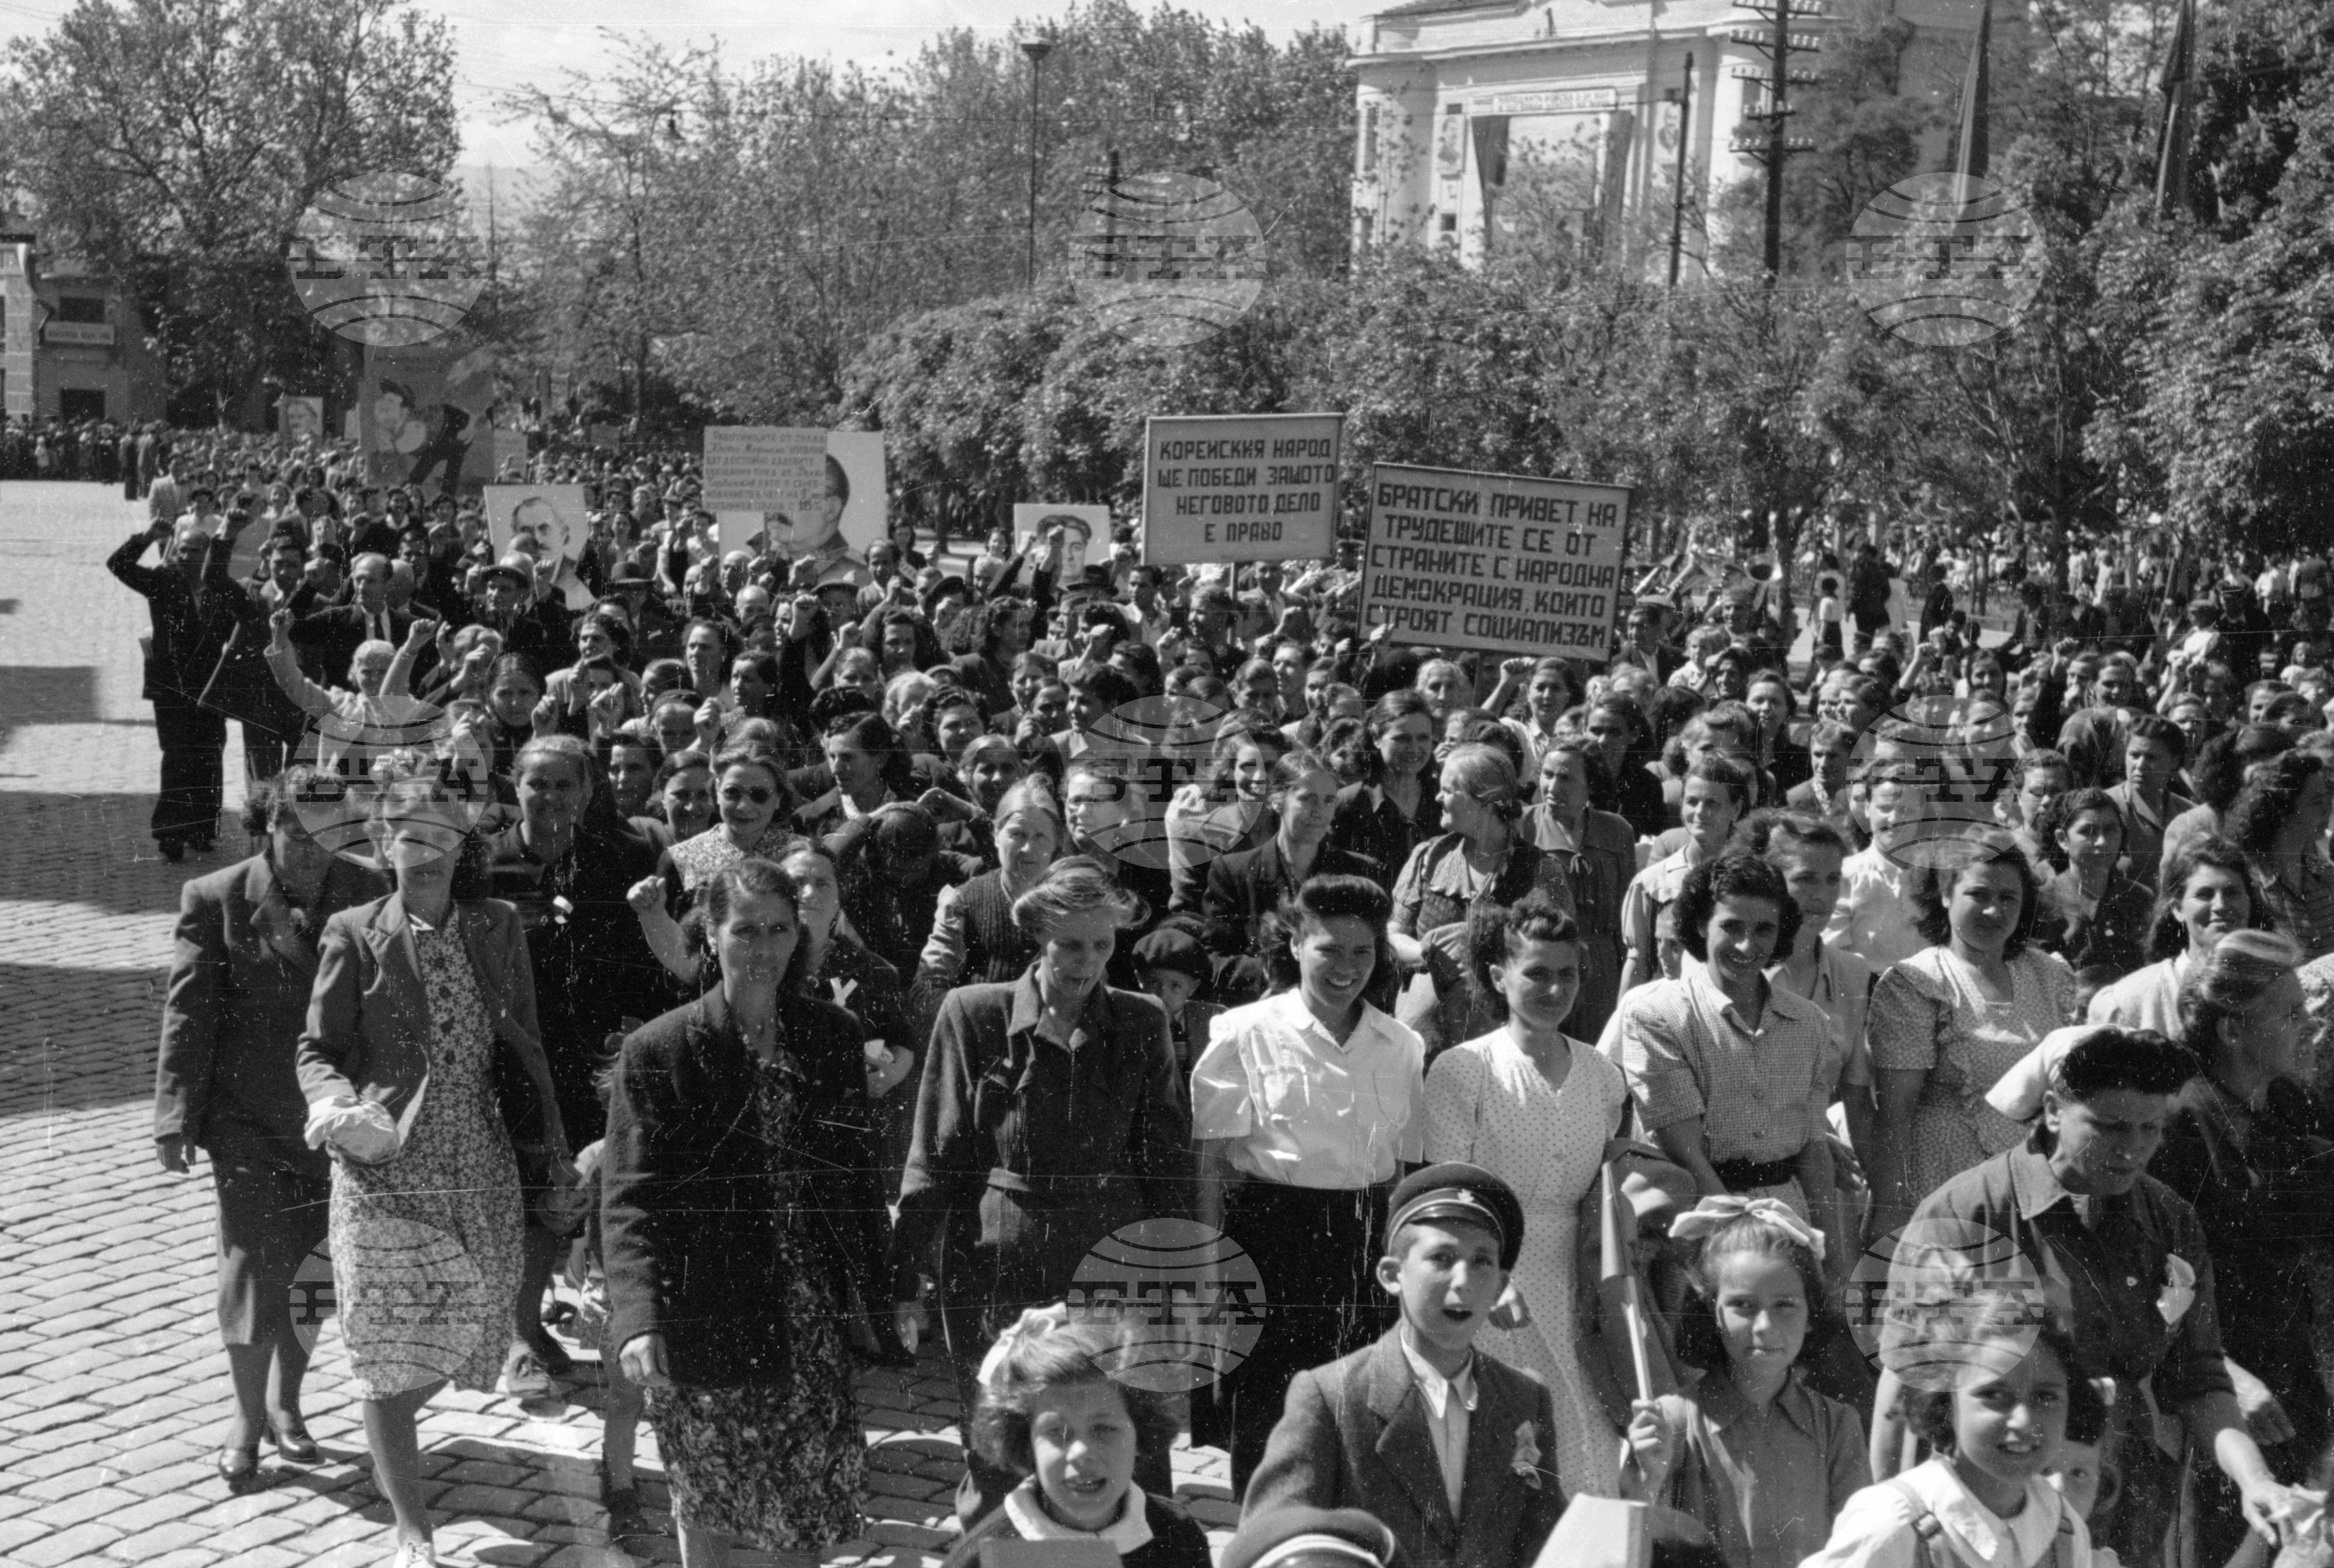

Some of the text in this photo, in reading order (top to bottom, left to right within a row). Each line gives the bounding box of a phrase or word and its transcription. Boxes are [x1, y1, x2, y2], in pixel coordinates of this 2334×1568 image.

[1273, 439, 1331, 458] НАРОД
[1187, 467, 1257, 487] ПОБЕДИ
[1267, 465, 1336, 486] ЗАЩОТО
[1176, 493, 1320, 515] НЕГОВОТО ДЕЛО
[1378, 483, 1617, 528] БРАТСКИ ПРИВЕТ НА
[1204, 522, 1283, 543] Е ПРАВО
[1385, 514, 1598, 557] ТРУДЕЩИТЕ СЕ ОТ
[1371, 544, 1615, 589] СТРАНИТЕ С НАРОДНА
[1372, 575, 1606, 618] ДЕМОКРАЦИЯ, КОИТО
[1365, 603, 1606, 649] СТРОЯТ СОЦИАЛИЗЪМ
